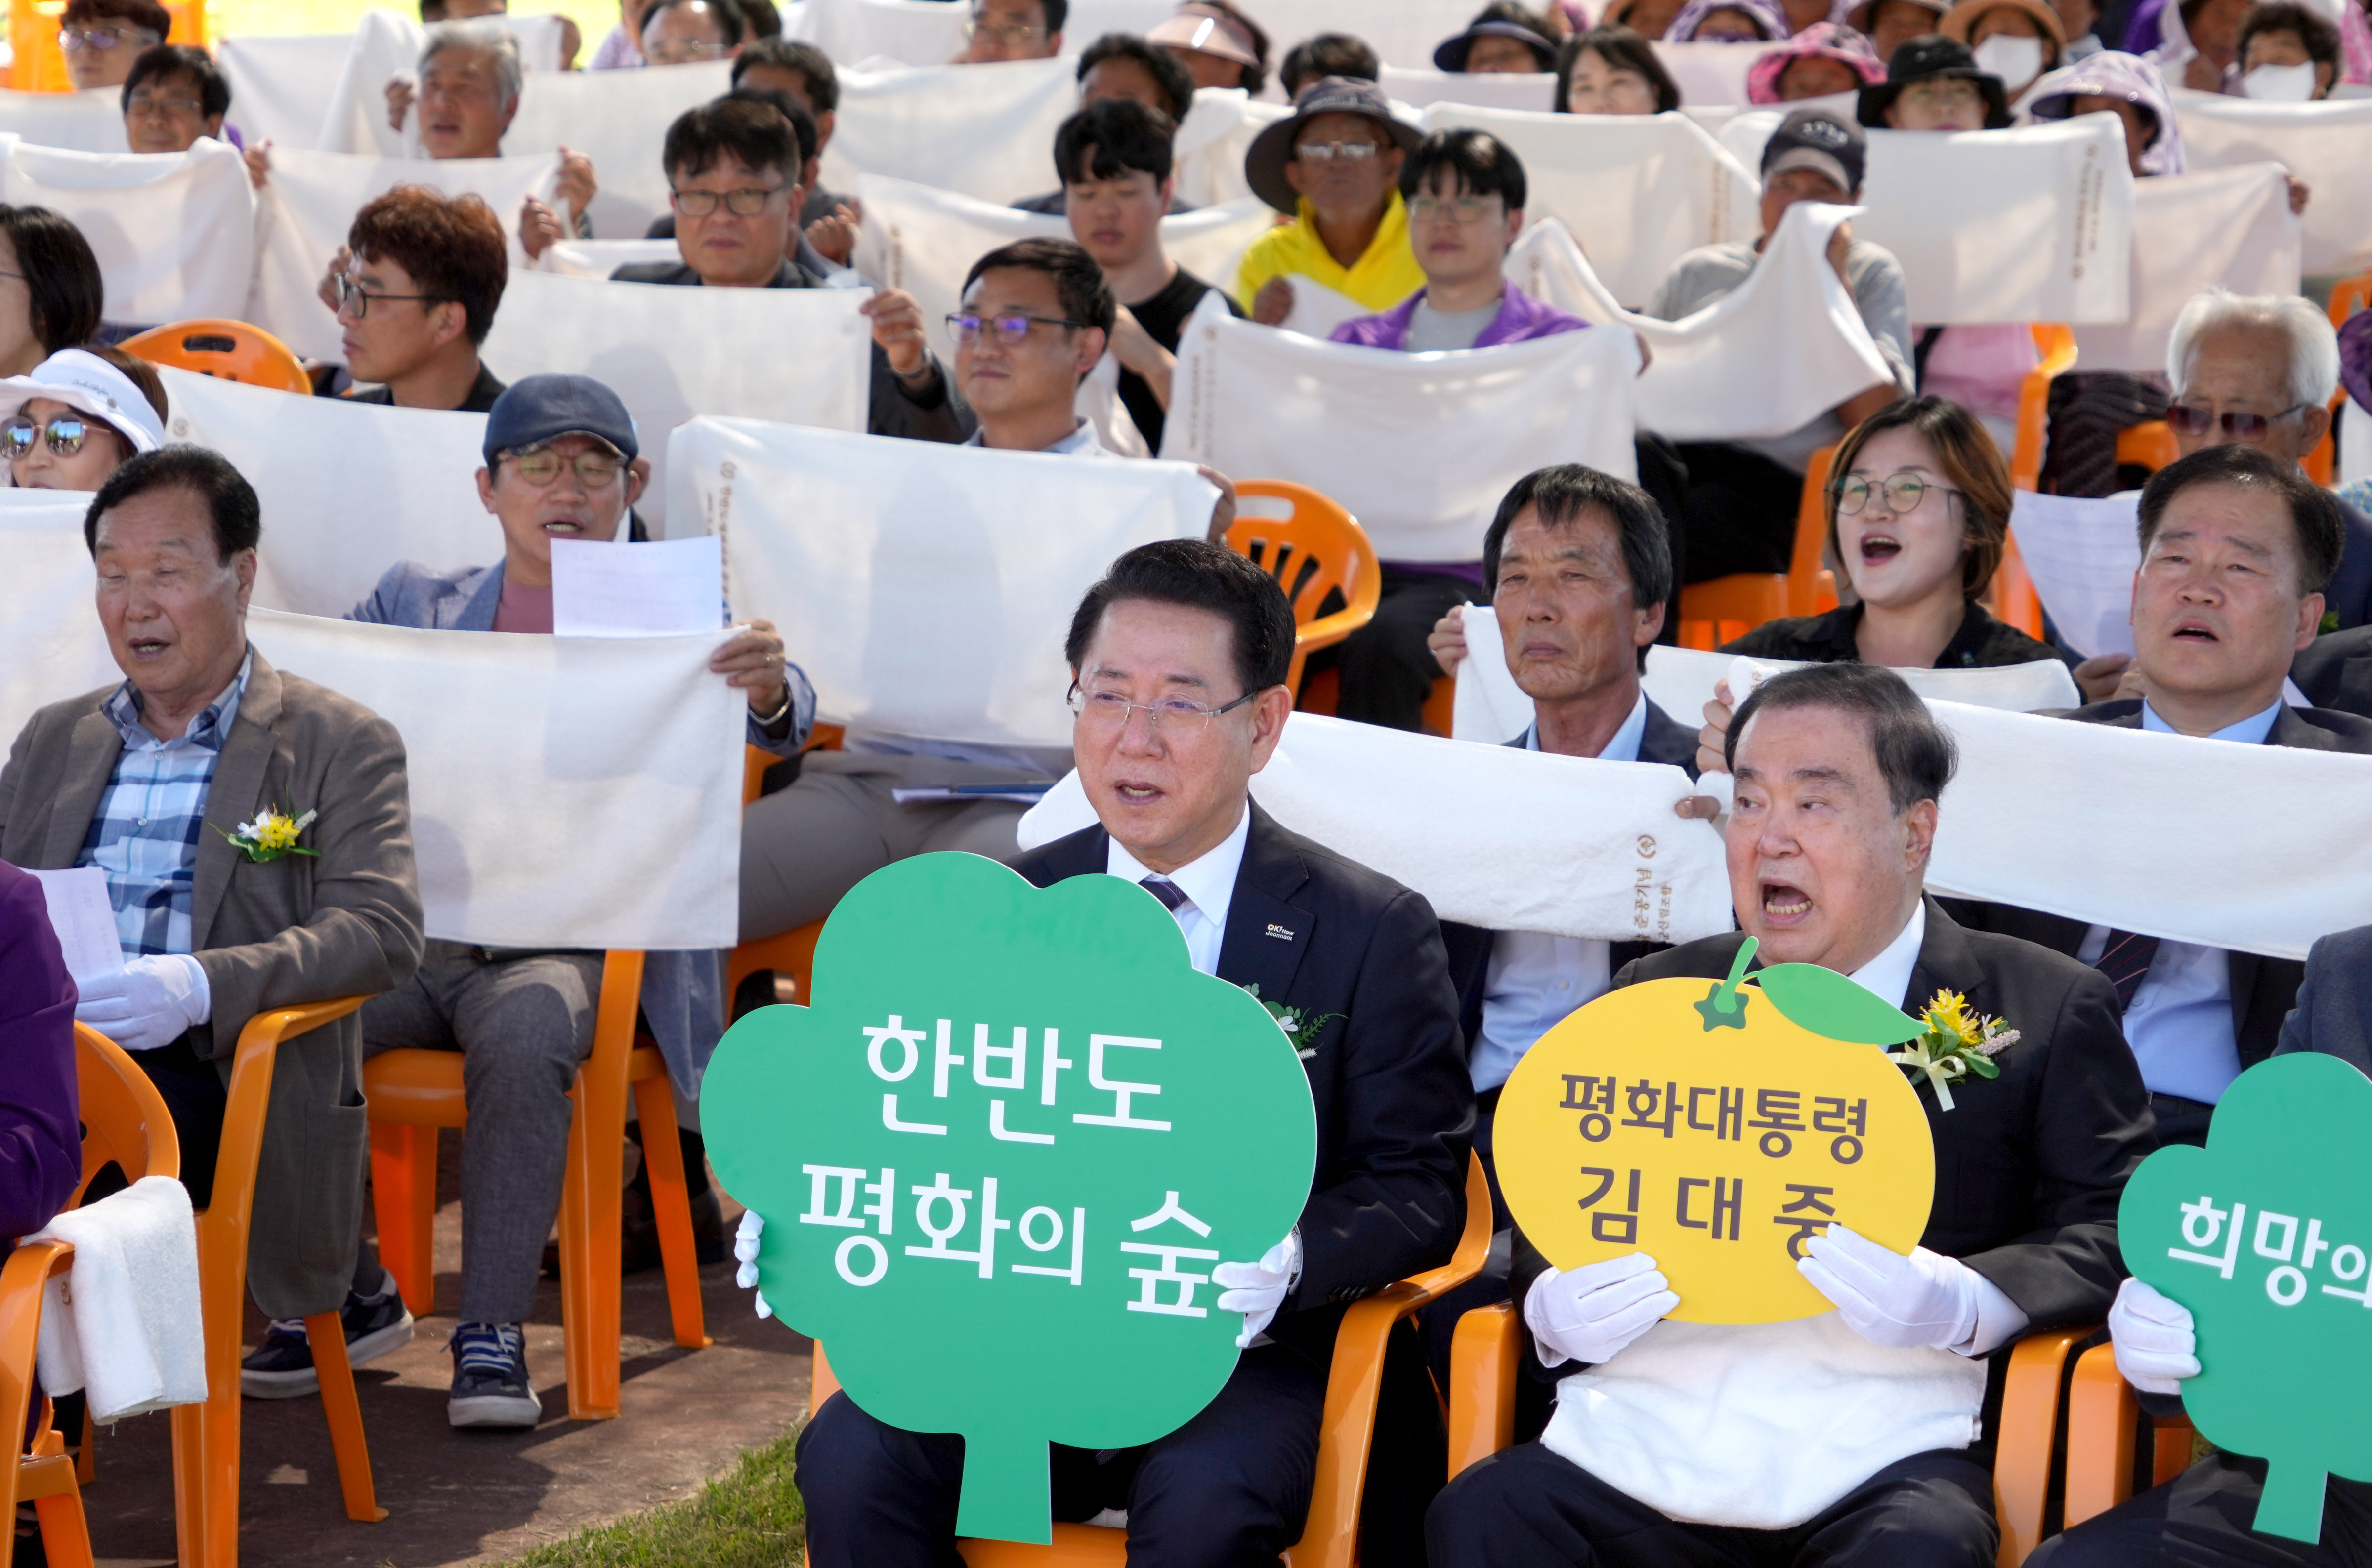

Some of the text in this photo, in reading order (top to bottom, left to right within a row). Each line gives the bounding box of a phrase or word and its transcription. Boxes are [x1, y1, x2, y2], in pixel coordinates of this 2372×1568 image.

[1266, 931, 1292, 941] Jeonnam
[1635, 868, 1652, 928] 준공기념
[863, 1015, 1171, 1145] 한반도
[1560, 1073, 1867, 1165] 평화대통령
[800, 1164, 1219, 1318] 평화의 숲
[2168, 1196, 2372, 1308] 희망의
